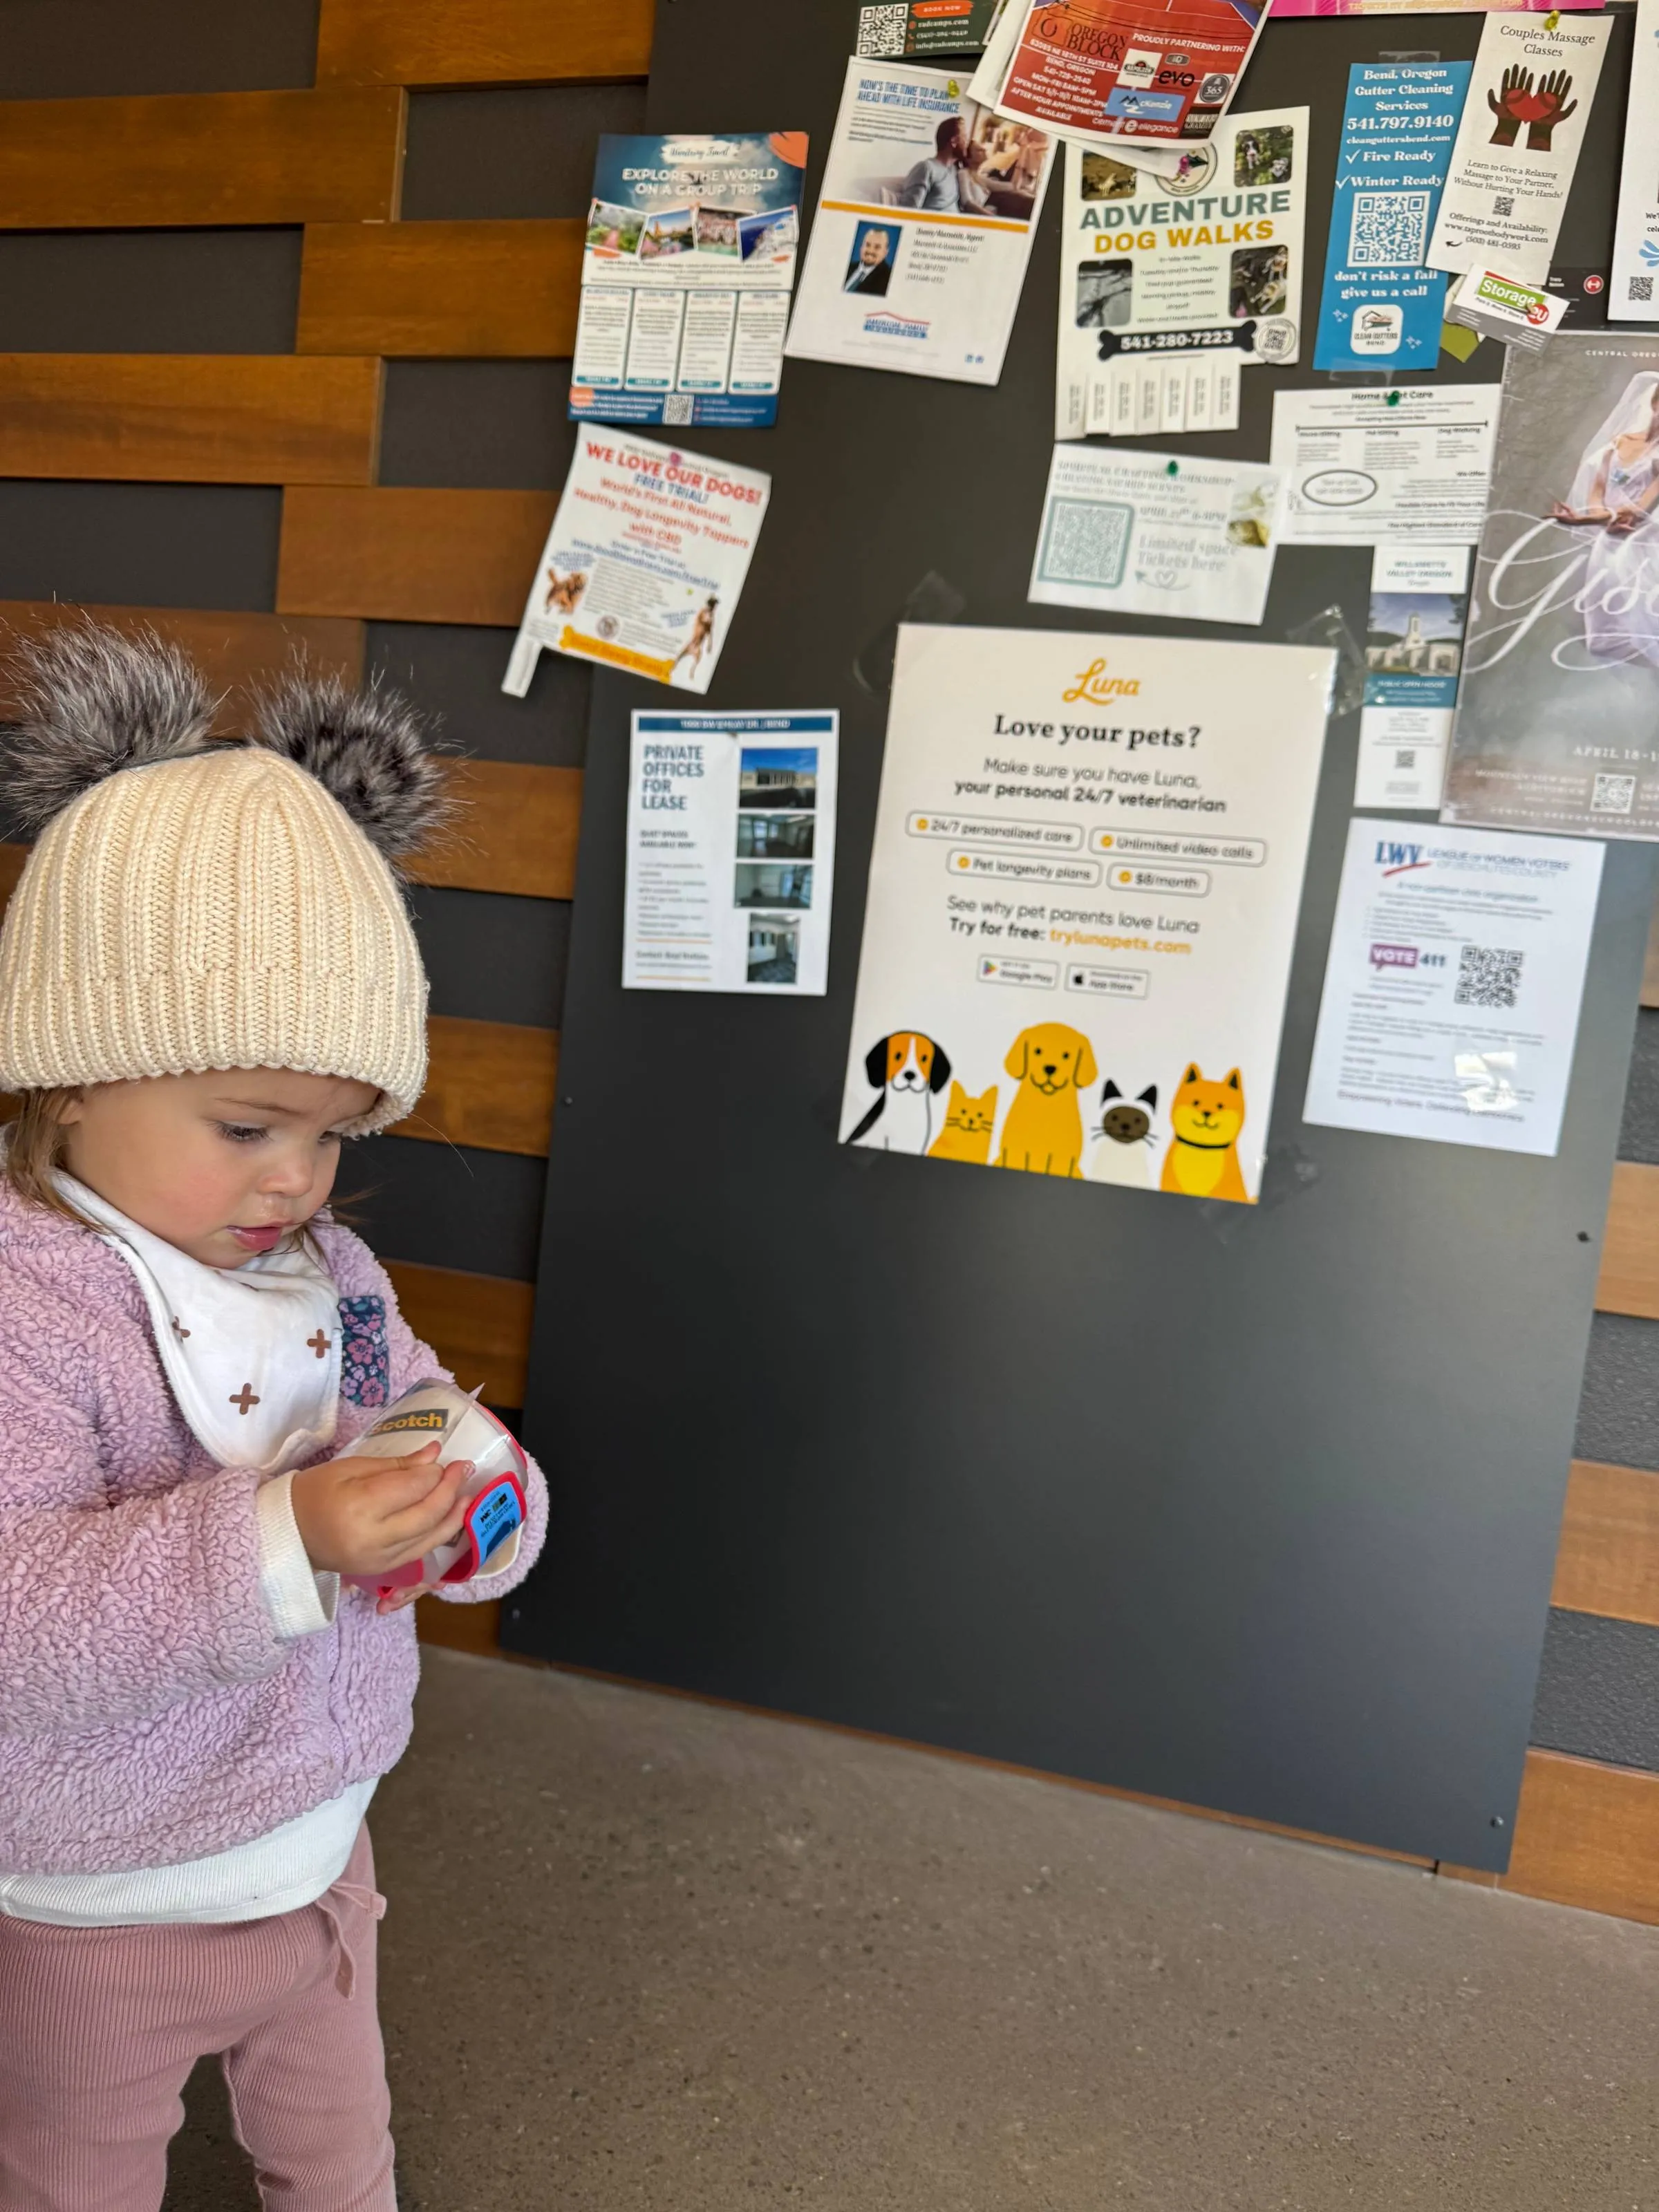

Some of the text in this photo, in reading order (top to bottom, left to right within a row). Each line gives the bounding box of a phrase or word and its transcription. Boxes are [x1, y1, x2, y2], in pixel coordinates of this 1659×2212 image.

[1071, 24, 1129, 47] OREGON
[1132, 32, 1246, 53] PROUDLY PARTNERING WITH:
[1500, 25, 1596, 44] Couples Massage
[1067, 34, 1121, 61] BLOCK
[1523, 44, 1564, 57] Classes
[1158, 71, 1194, 86] evo
[1401, 68, 1447, 79] Oregon
[1205, 86, 1222, 94] 365
[1355, 84, 1454, 96] Gutter Cleaning
[901, 96, 917, 108] LIFE
[918, 98, 960, 113] INSURANCE
[1375, 101, 1429, 111] Services
[1347, 115, 1454, 130] 541.797.9140
[1346, 135, 1451, 145] cleanguttersbend.com
[1362, 150, 1436, 162] Fire Ready
[622, 168, 779, 182] EXPLORE THE WORLD
[1463, 169, 1523, 185] Massage to Your
[1468, 159, 1489, 169] Learn
[1500, 165, 1517, 174] Give
[1525, 168, 1557, 180] Relaxing
[635, 184, 762, 196] ON A GROUP TRIP
[1350, 174, 1444, 187] Winter Ready
[1454, 176, 1564, 199] Without Hurting Your Hands!
[1079, 190, 1291, 230] ADVENTURE
[1449, 212, 1485, 226] Offerings
[1502, 221, 1548, 234] Availability:
[1094, 220, 1274, 254] DOG WALKS
[1334, 270, 1368, 281] don't
[1370, 270, 1400, 281] risk
[1414, 268, 1438, 280] fall
[1340, 286, 1369, 299] give
[1371, 289, 1387, 297] us
[1401, 285, 1428, 297] call
[1481, 279, 1537, 307] Storage
[1120, 329, 1235, 350] 541-280-7223
[1351, 391, 1434, 401] Home Care
[585, 442, 614, 462] WE
[618, 453, 662, 476] LOVE
[666, 466, 703, 487] OUR
[706, 478, 762, 505] DOGS!
[634, 474, 709, 504] FREE TRIAL!
[644, 489, 668, 504] First
[645, 510, 700, 535] Longevity
[703, 525, 749, 548] Toppers
[1062, 658, 1142, 706] Luna
[993, 715, 1201, 751] Love your pets?
[643, 744, 704, 760] PRIVATE
[1572, 745, 1618, 759] APRIL
[642, 762, 704, 778] OFFICES
[983, 758, 1029, 776] Make
[1032, 765, 1067, 778] sure
[1071, 767, 1105, 783] you
[1107, 767, 1150, 785] have
[641, 779, 672, 794] FOR
[641, 796, 687, 811] LEASE
[954, 780, 1227, 813] your personal 24/7 veterinarian
[931, 819, 1074, 843] 24/7 personalized care
[1116, 836, 1255, 859] Unlimited video calls
[1375, 842, 1422, 864] LWV
[1427, 849, 1570, 870] LEAGUE WOMEN VOTERS
[973, 858, 1091, 881] Pet longevity plans
[947, 894, 1201, 935] See why pet parents love Luna
[949, 916, 1193, 955] Try for free: trylunapets.com
[1373, 947, 1445, 967] VOTE 411
[1000, 968, 1031, 982] Google
[1089, 980, 1134, 992] App Store
